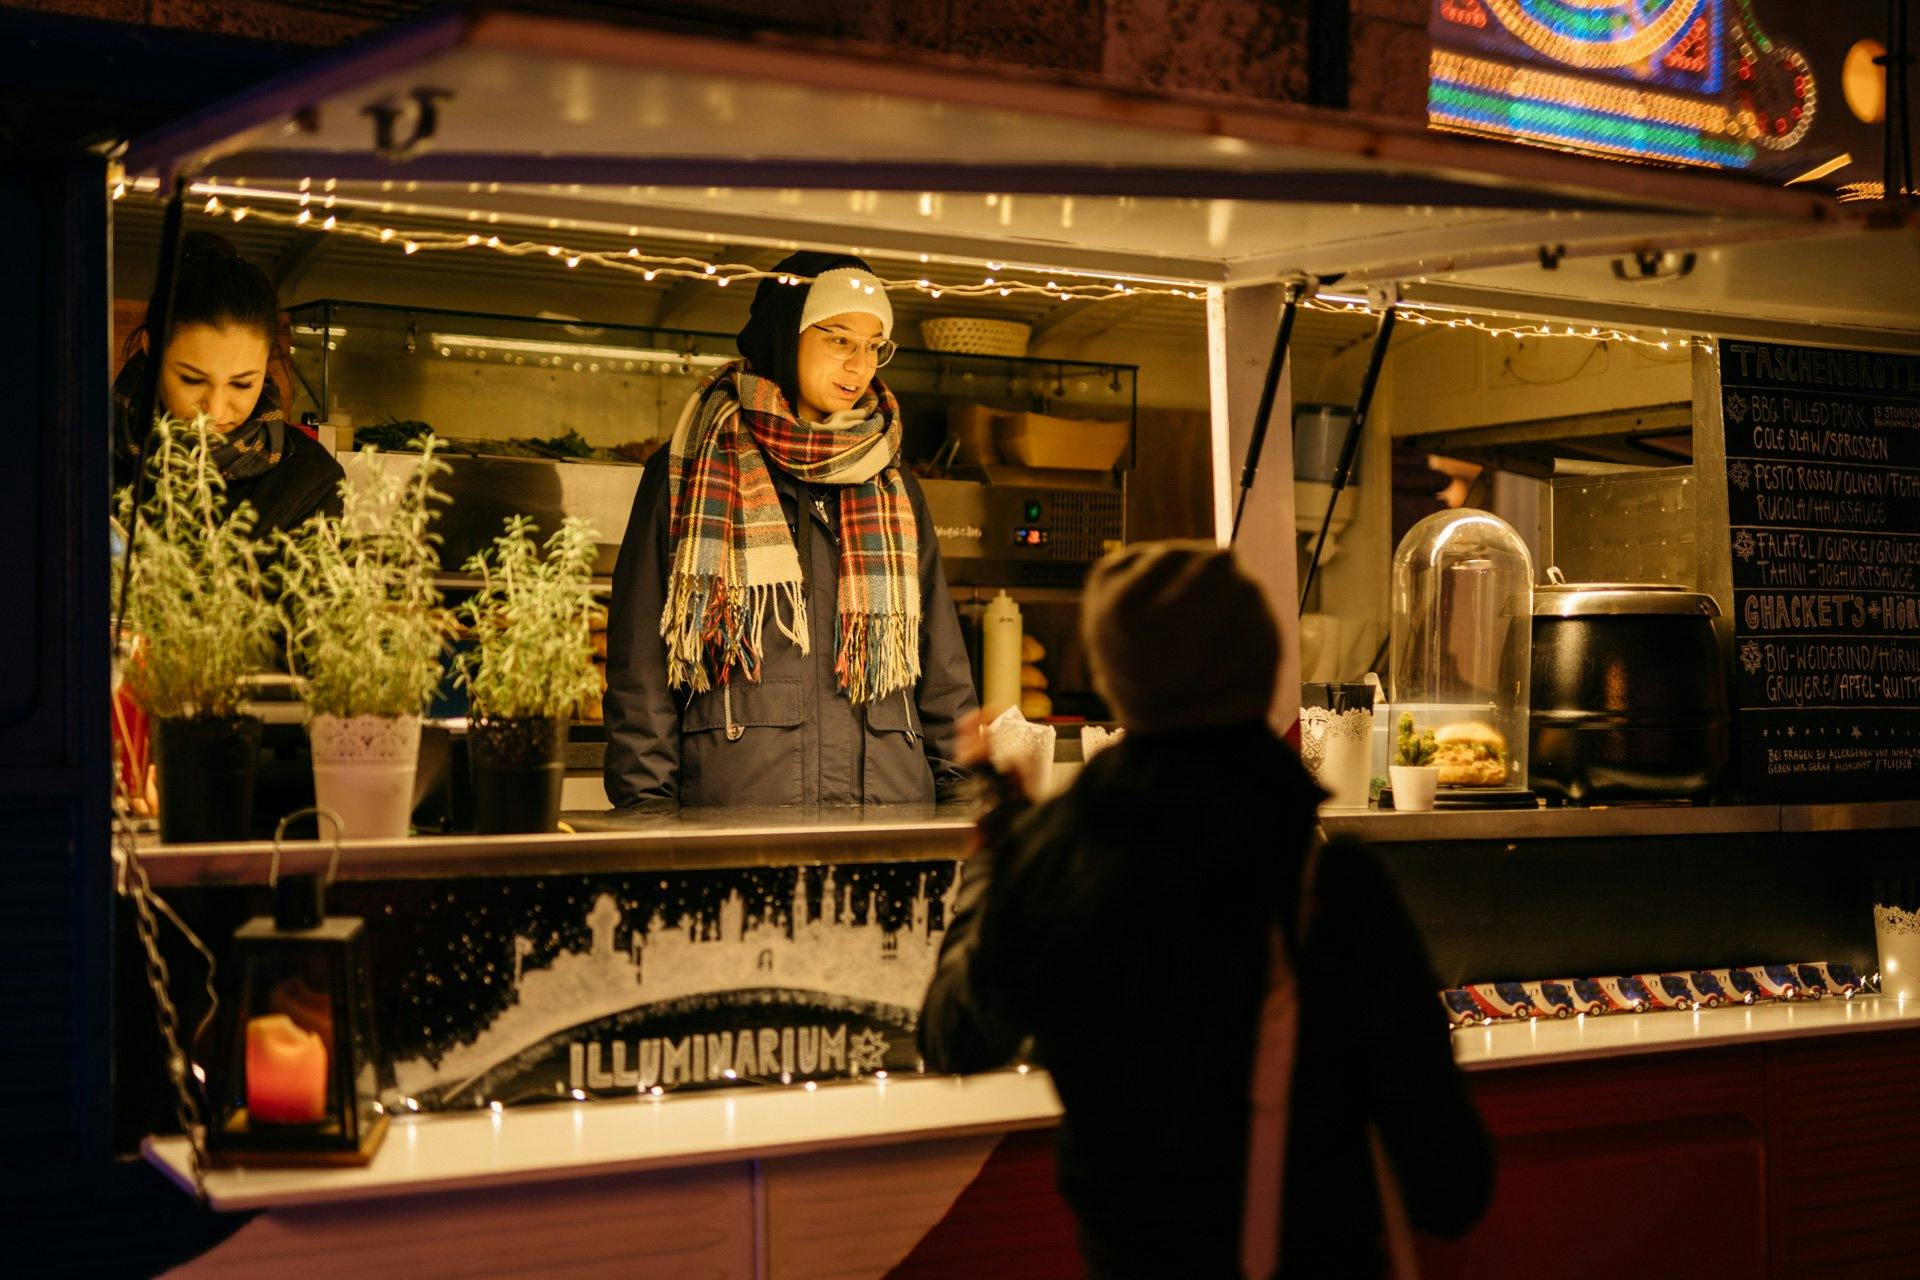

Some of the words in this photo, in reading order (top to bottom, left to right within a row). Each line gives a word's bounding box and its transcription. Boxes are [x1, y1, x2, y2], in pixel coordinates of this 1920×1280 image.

[1751, 394, 1779, 423] BBQ
[1782, 397, 1829, 427] PULLED
[1832, 402, 1869, 431] PORK
[1753, 426, 1786, 450] COLE
[1754, 463, 1794, 492] PESTO
[569, 1023, 847, 1089] ILLUMINARIUM
